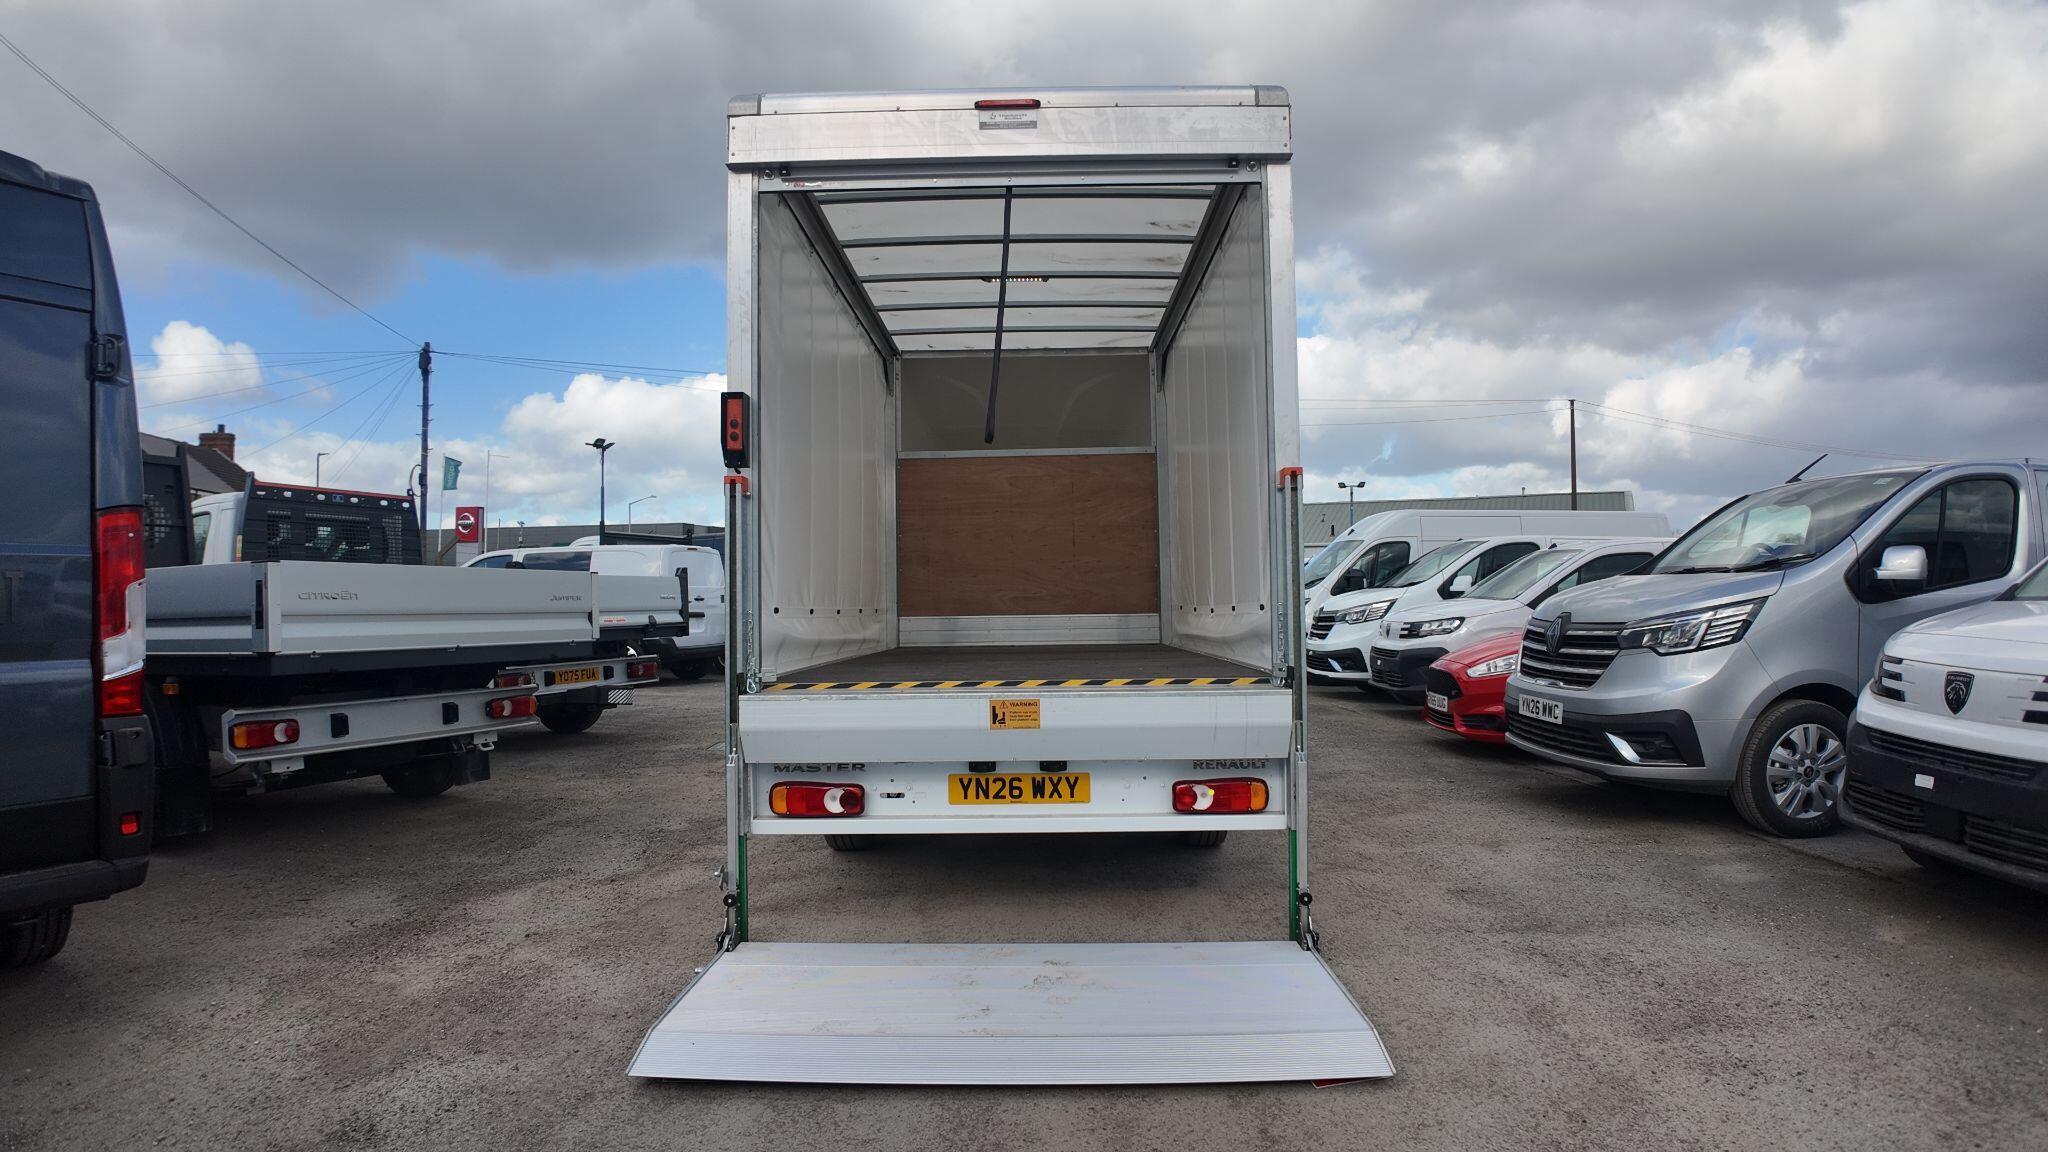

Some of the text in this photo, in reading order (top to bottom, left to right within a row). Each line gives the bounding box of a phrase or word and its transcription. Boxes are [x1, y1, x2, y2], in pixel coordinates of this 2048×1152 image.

[581, 667, 596, 680] FUA
[1522, 696, 1540, 716] YN26
[774, 762, 866, 773] MASTER
[1193, 758, 1269, 770] RENAULT
[959, 776, 1079, 800] YN26 WXY
